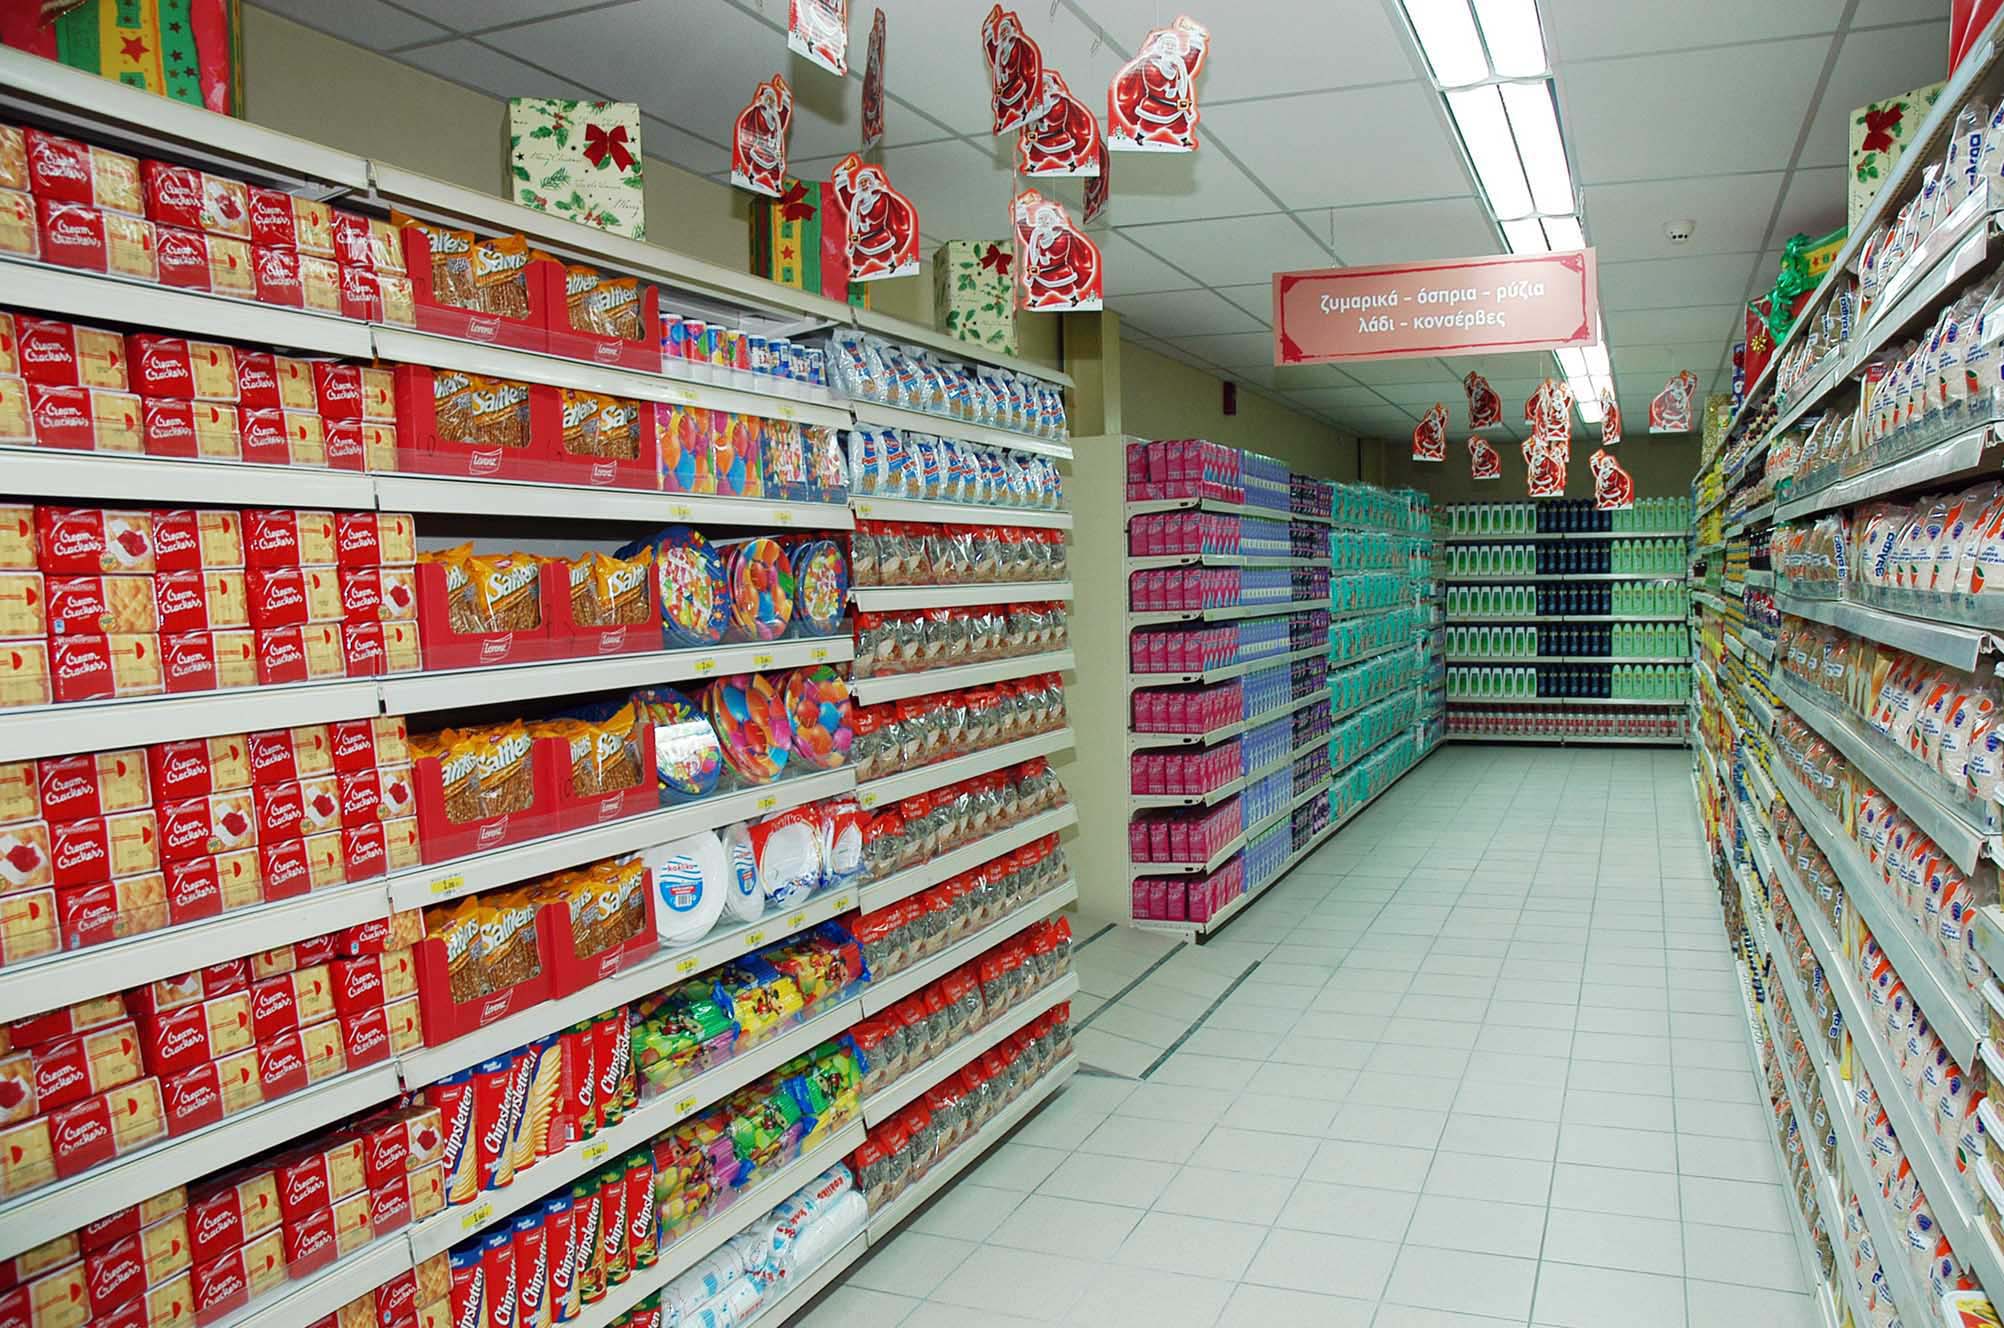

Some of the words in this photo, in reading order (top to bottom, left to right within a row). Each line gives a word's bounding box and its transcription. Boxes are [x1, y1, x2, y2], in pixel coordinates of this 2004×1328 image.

[1320, 289, 1397, 314] ζυμαρικά
[1417, 286, 1477, 306] όσπρια
[1496, 280, 1545, 303] ρύζια
[1358, 314, 1395, 333] λάδι
[1413, 309, 1506, 331] κονσέρβες
